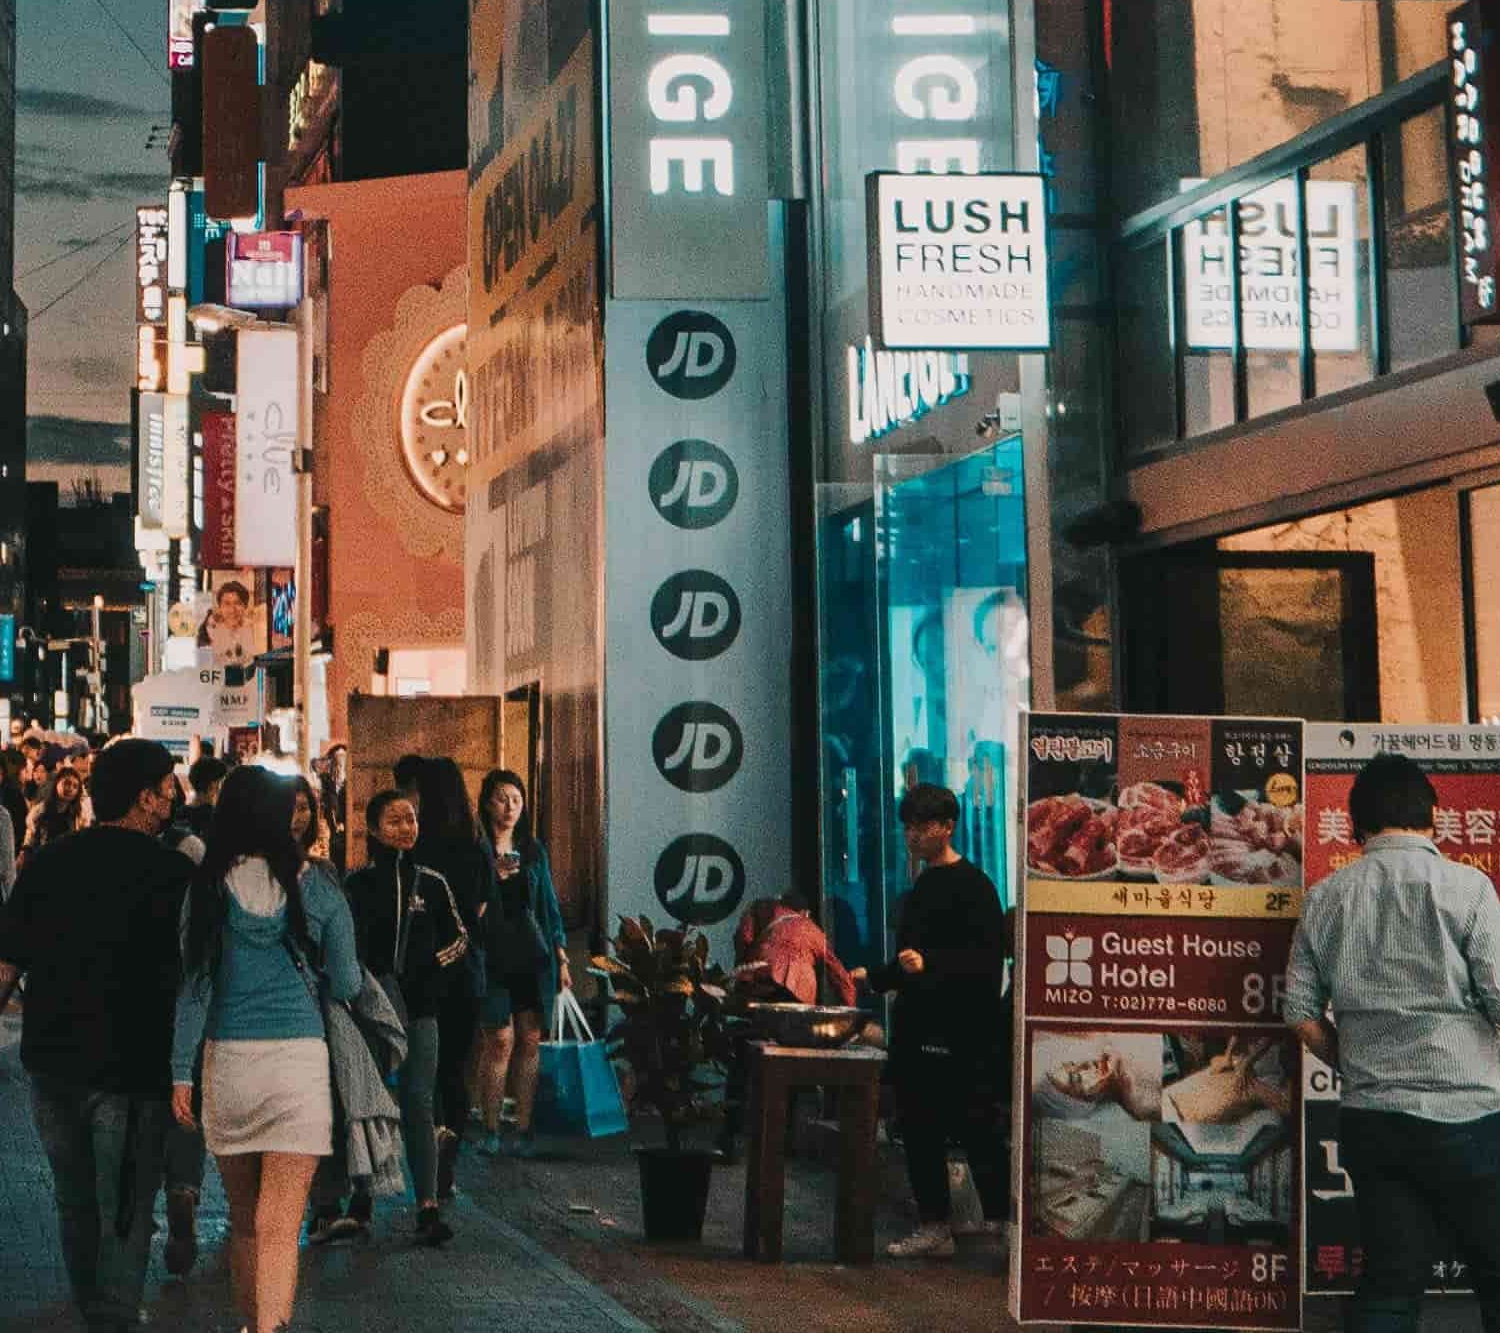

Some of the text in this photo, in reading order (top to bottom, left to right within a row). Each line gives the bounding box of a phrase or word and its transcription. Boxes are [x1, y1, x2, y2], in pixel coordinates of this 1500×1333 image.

[893, 199, 1031, 234] LUSH
[895, 244, 1032, 274] FRESH
[896, 284, 1034, 301] HANDMADE
[897, 308, 1035, 326] COSMETICS
[660, 331, 725, 378] JD
[661, 461, 727, 508] JD
[664, 590, 730, 638] JD
[667, 722, 732, 771] JD
[1224, 742, 1293, 767] 항정살
[669, 854, 734, 903] JD
[1111, 886, 1291, 911] 새마을식당 2F
[1101, 932, 1263, 958] Guest House
[1101, 963, 1176, 988] Hotel
[1045, 987, 1094, 1005] MIZO
[1251, 1252, 1289, 1283] 8F
